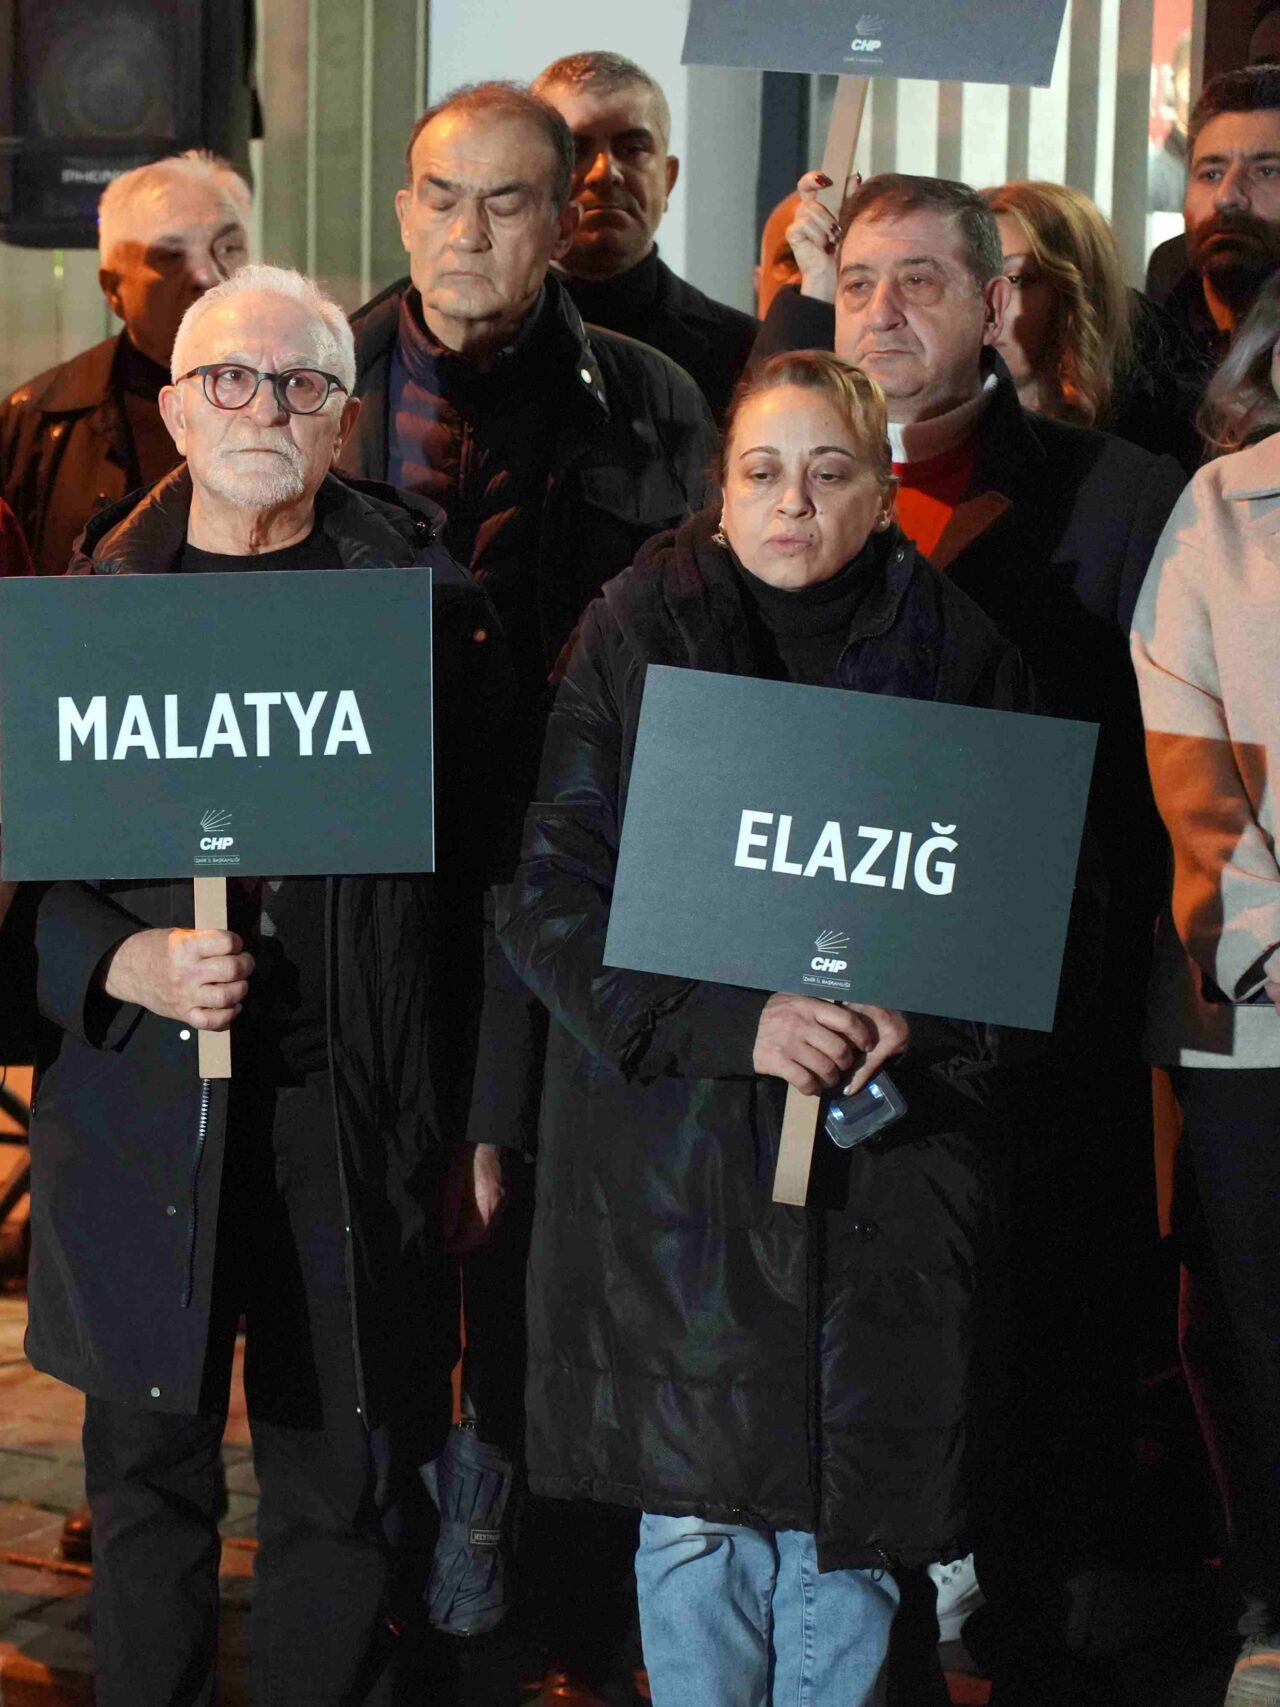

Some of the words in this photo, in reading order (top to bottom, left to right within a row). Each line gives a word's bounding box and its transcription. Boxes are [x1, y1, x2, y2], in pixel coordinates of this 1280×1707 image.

[850, 38, 882, 52] CHP
[58, 689, 373, 762] MALATYA
[199, 836, 234, 851] CHP
[733, 808, 959, 896] ELAZIĞ
[810, 956, 848, 973] CHP
